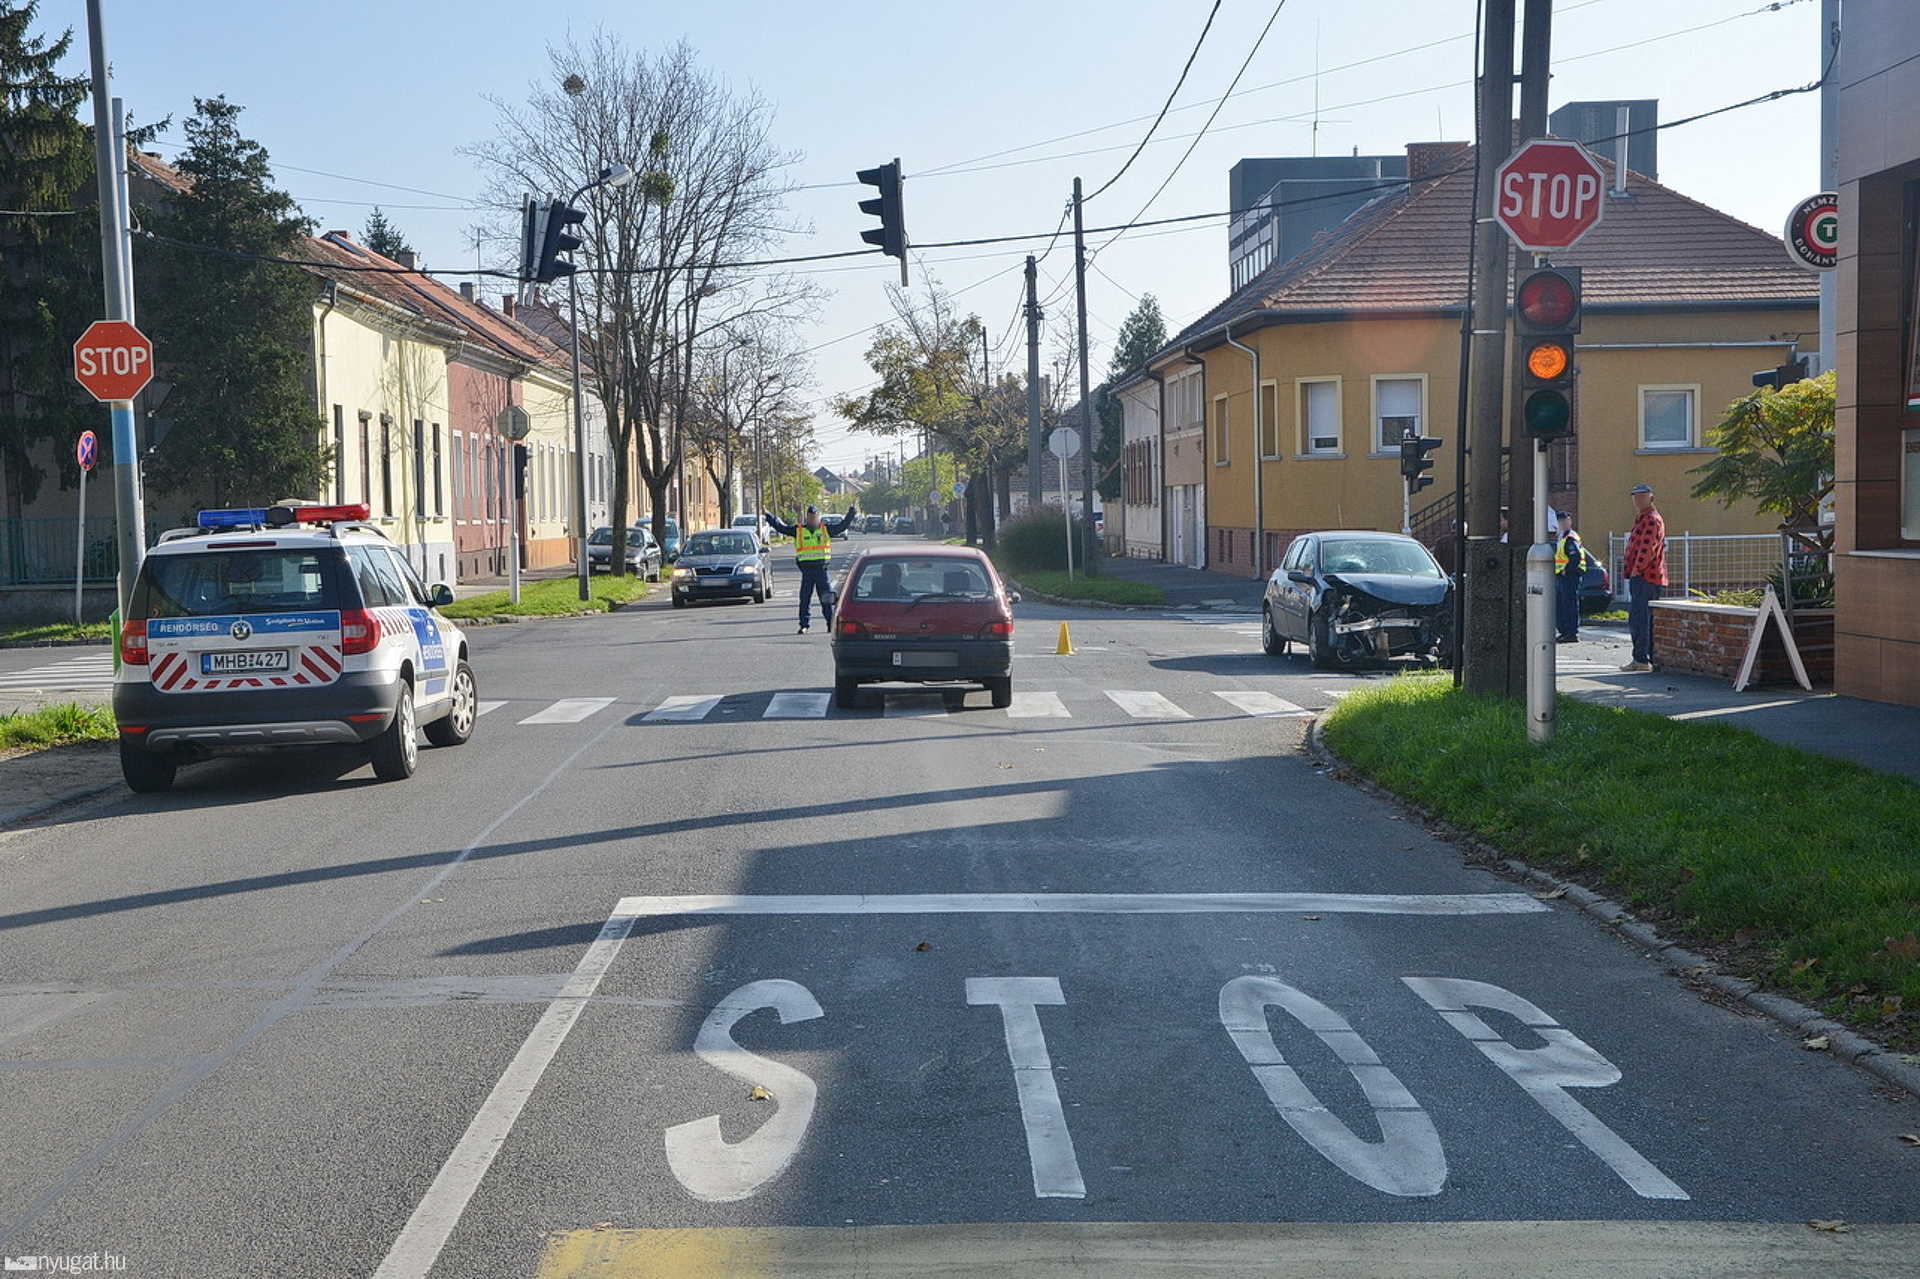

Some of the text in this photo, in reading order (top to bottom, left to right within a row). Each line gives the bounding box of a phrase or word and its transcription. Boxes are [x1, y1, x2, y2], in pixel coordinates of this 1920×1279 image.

[1503, 172, 1597, 219] STOP
[1823, 224, 1837, 237] T
[80, 346, 147, 376] STOP
[664, 975, 1691, 1202] STOP
